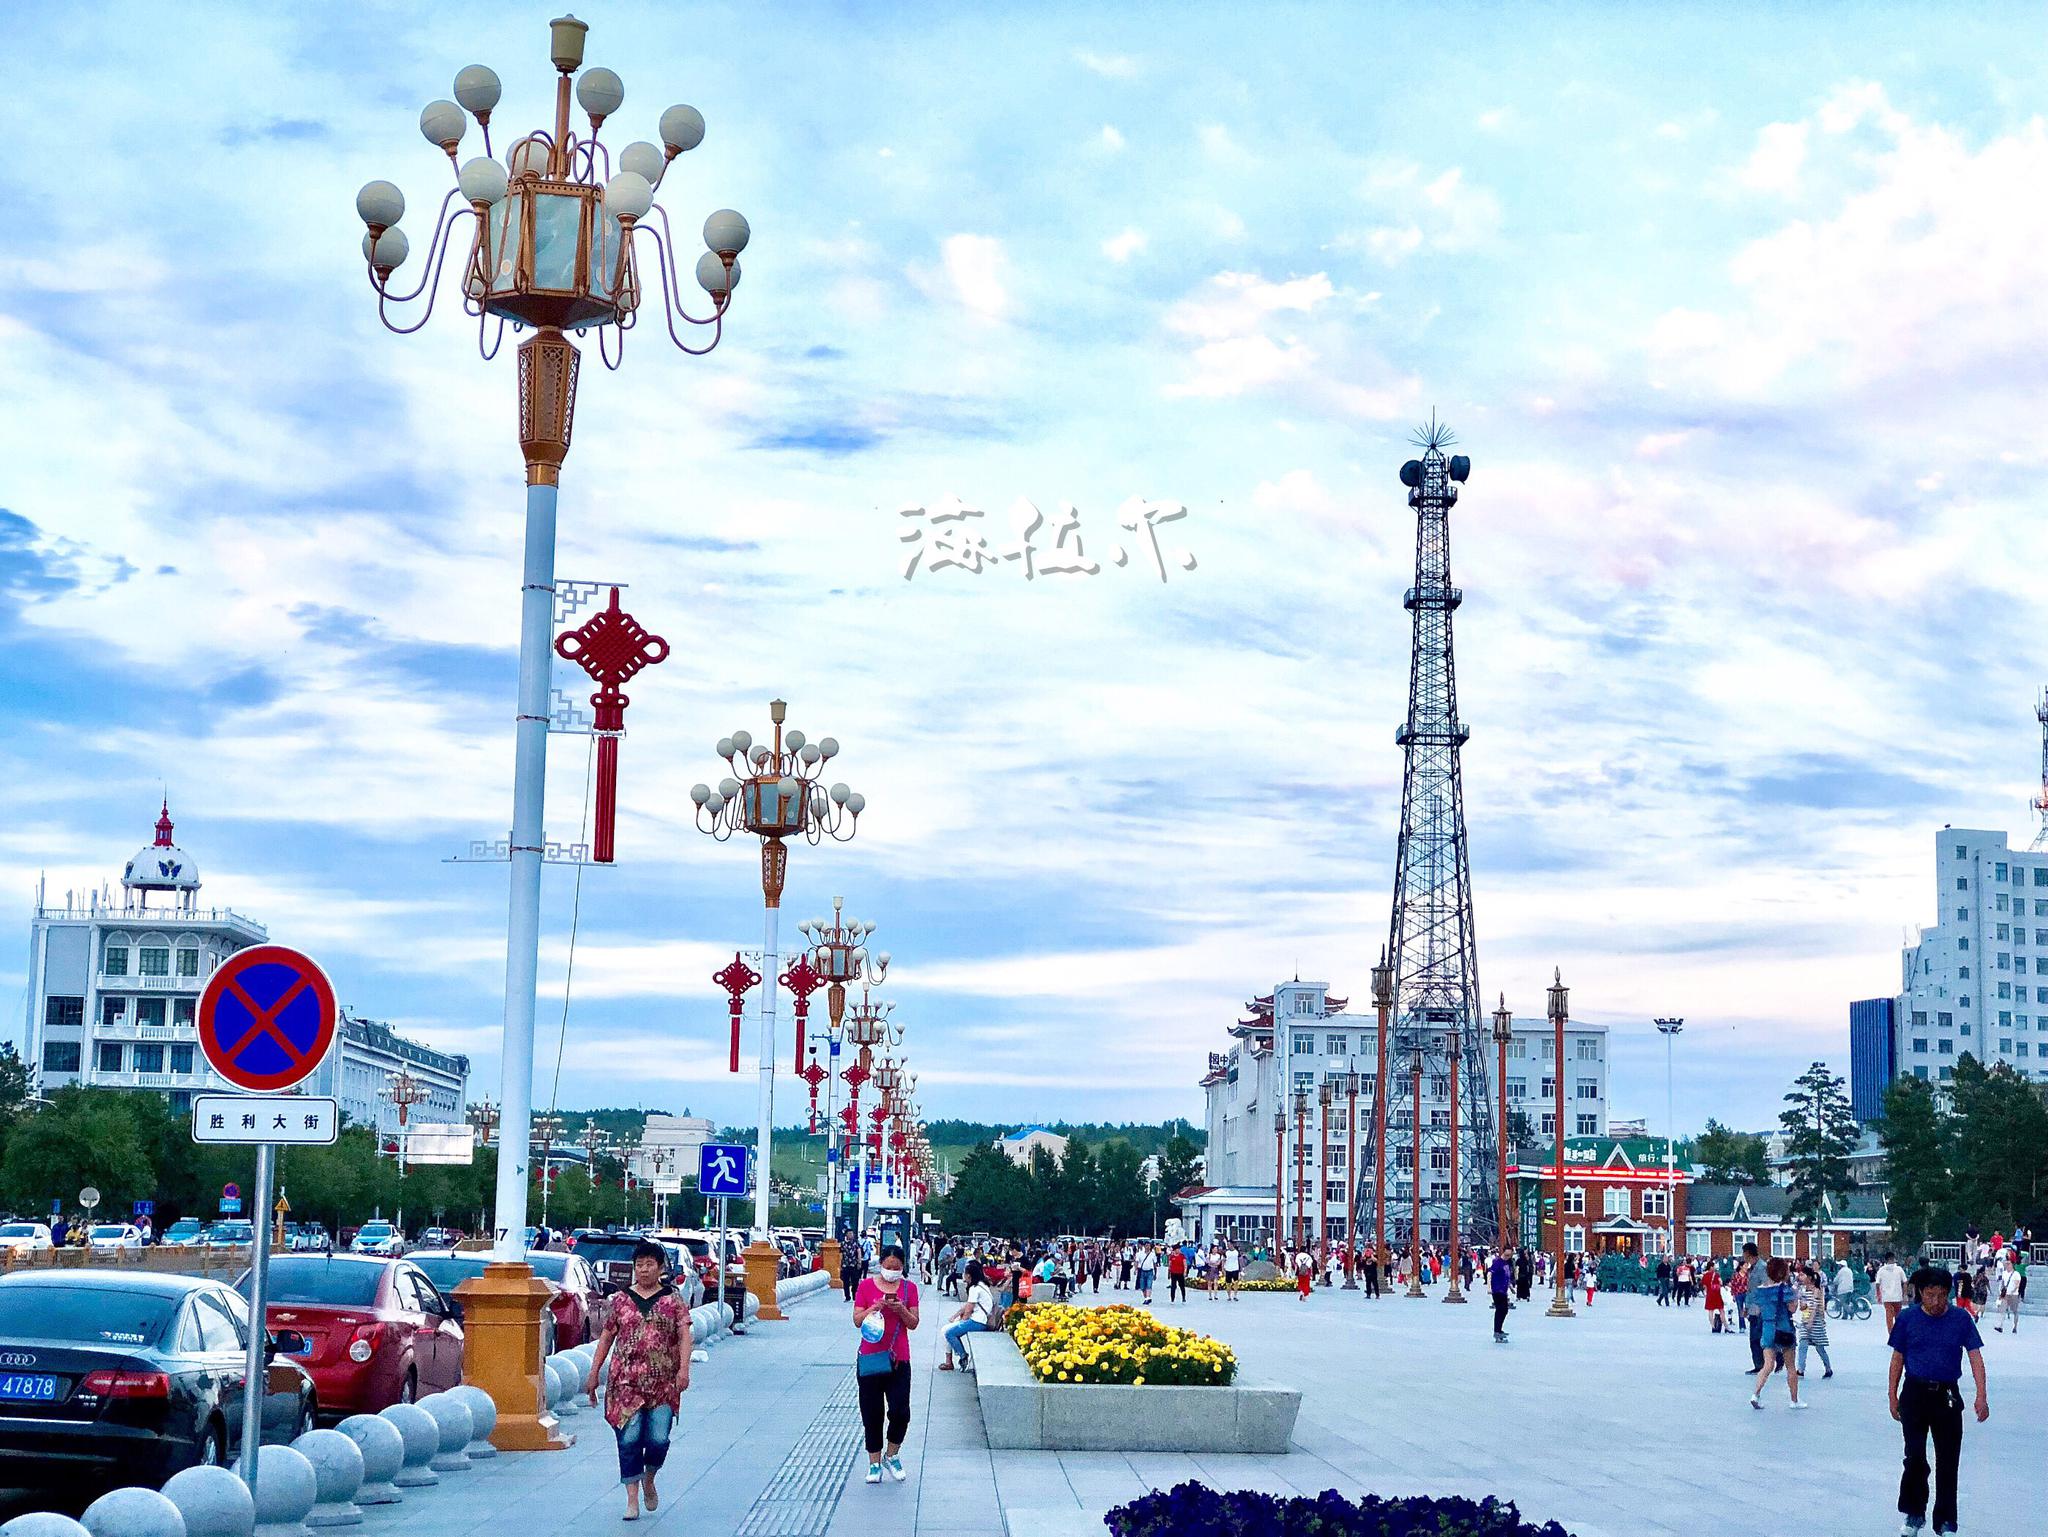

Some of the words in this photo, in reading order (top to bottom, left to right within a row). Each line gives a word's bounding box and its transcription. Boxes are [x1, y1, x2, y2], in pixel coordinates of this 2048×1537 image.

[210, 1113, 319, 1130] 胜利大街
[2, 1377, 54, 1396] 47878
